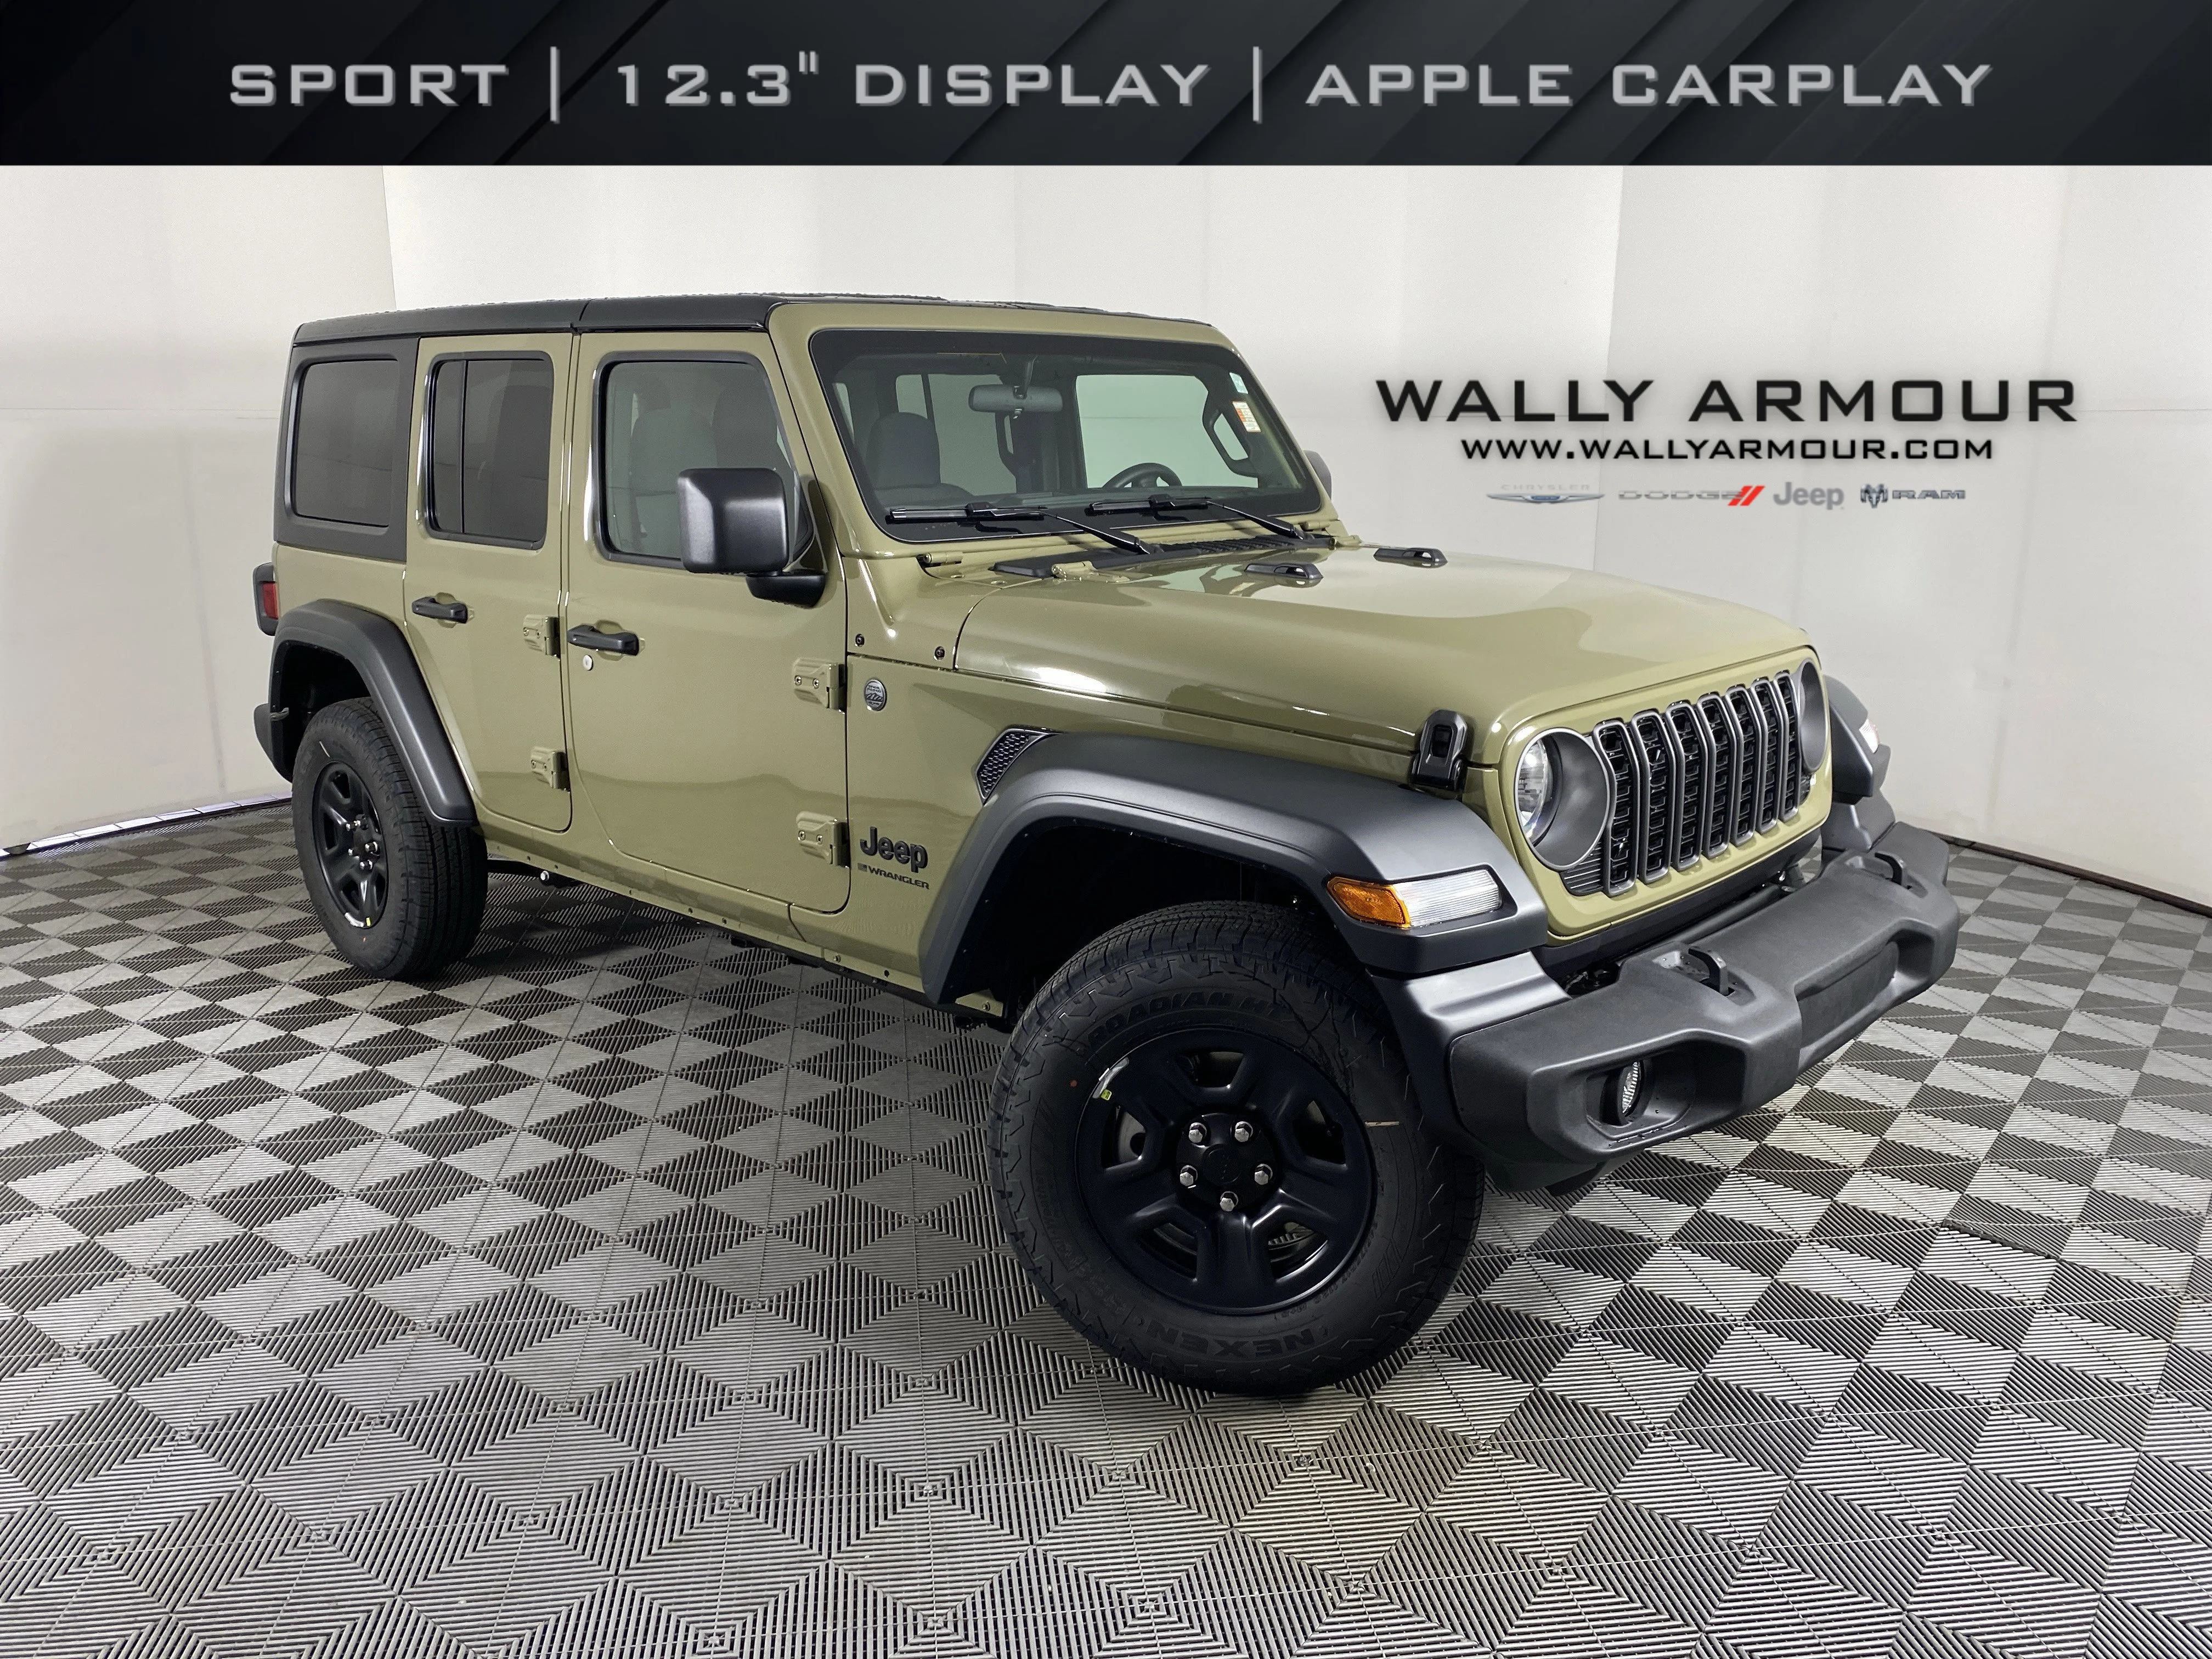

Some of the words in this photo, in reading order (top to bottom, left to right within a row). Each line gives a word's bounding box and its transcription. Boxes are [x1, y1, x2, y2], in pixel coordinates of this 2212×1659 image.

[860, 826, 928, 873] Jeep
[868, 865, 929, 890] WRANGLER
[1146, 1319, 1316, 1358] NEXEN
